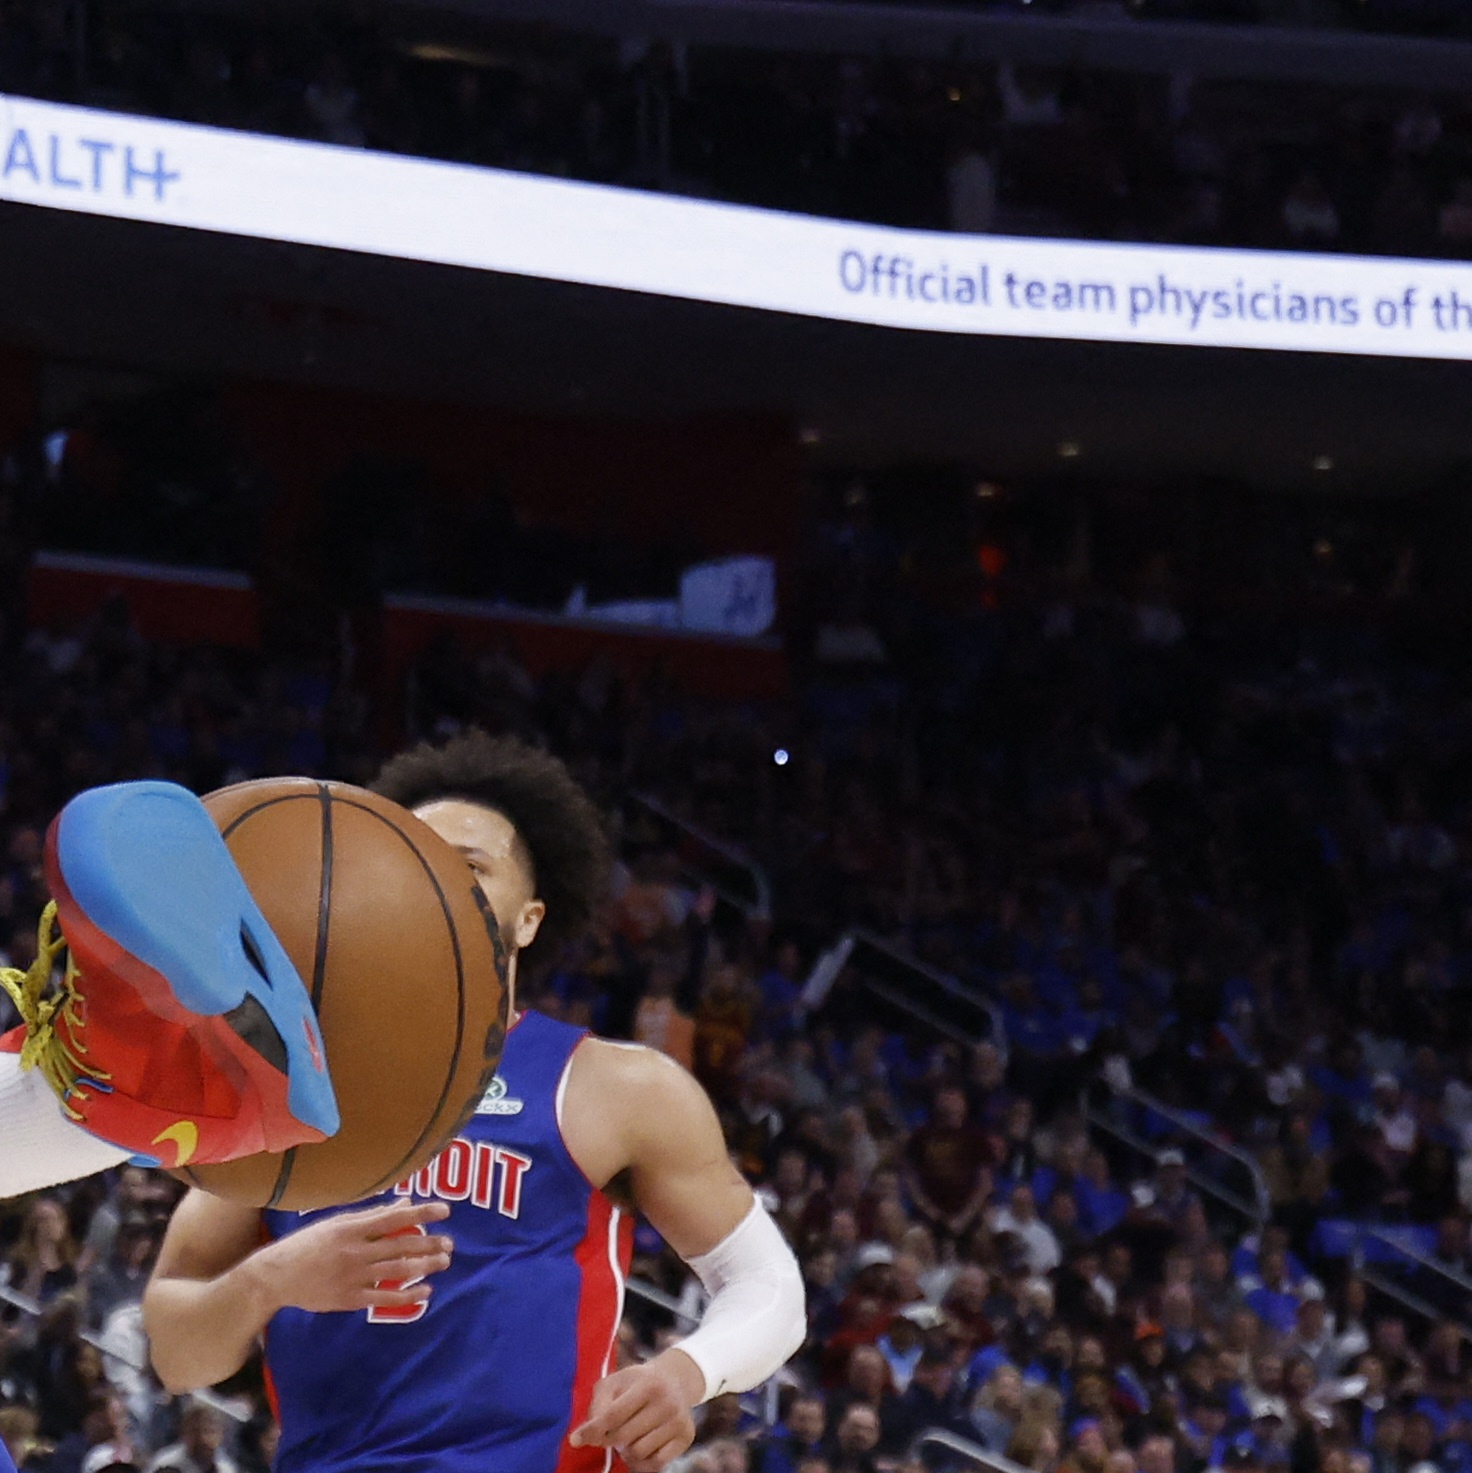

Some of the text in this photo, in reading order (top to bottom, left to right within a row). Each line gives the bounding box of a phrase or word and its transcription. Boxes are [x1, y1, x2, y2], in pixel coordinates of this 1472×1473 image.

[839, 248, 990, 307] Official
[1005, 272, 1117, 312] team
[1128, 273, 1360, 330] physicians
[1374, 286, 1417, 328] of
